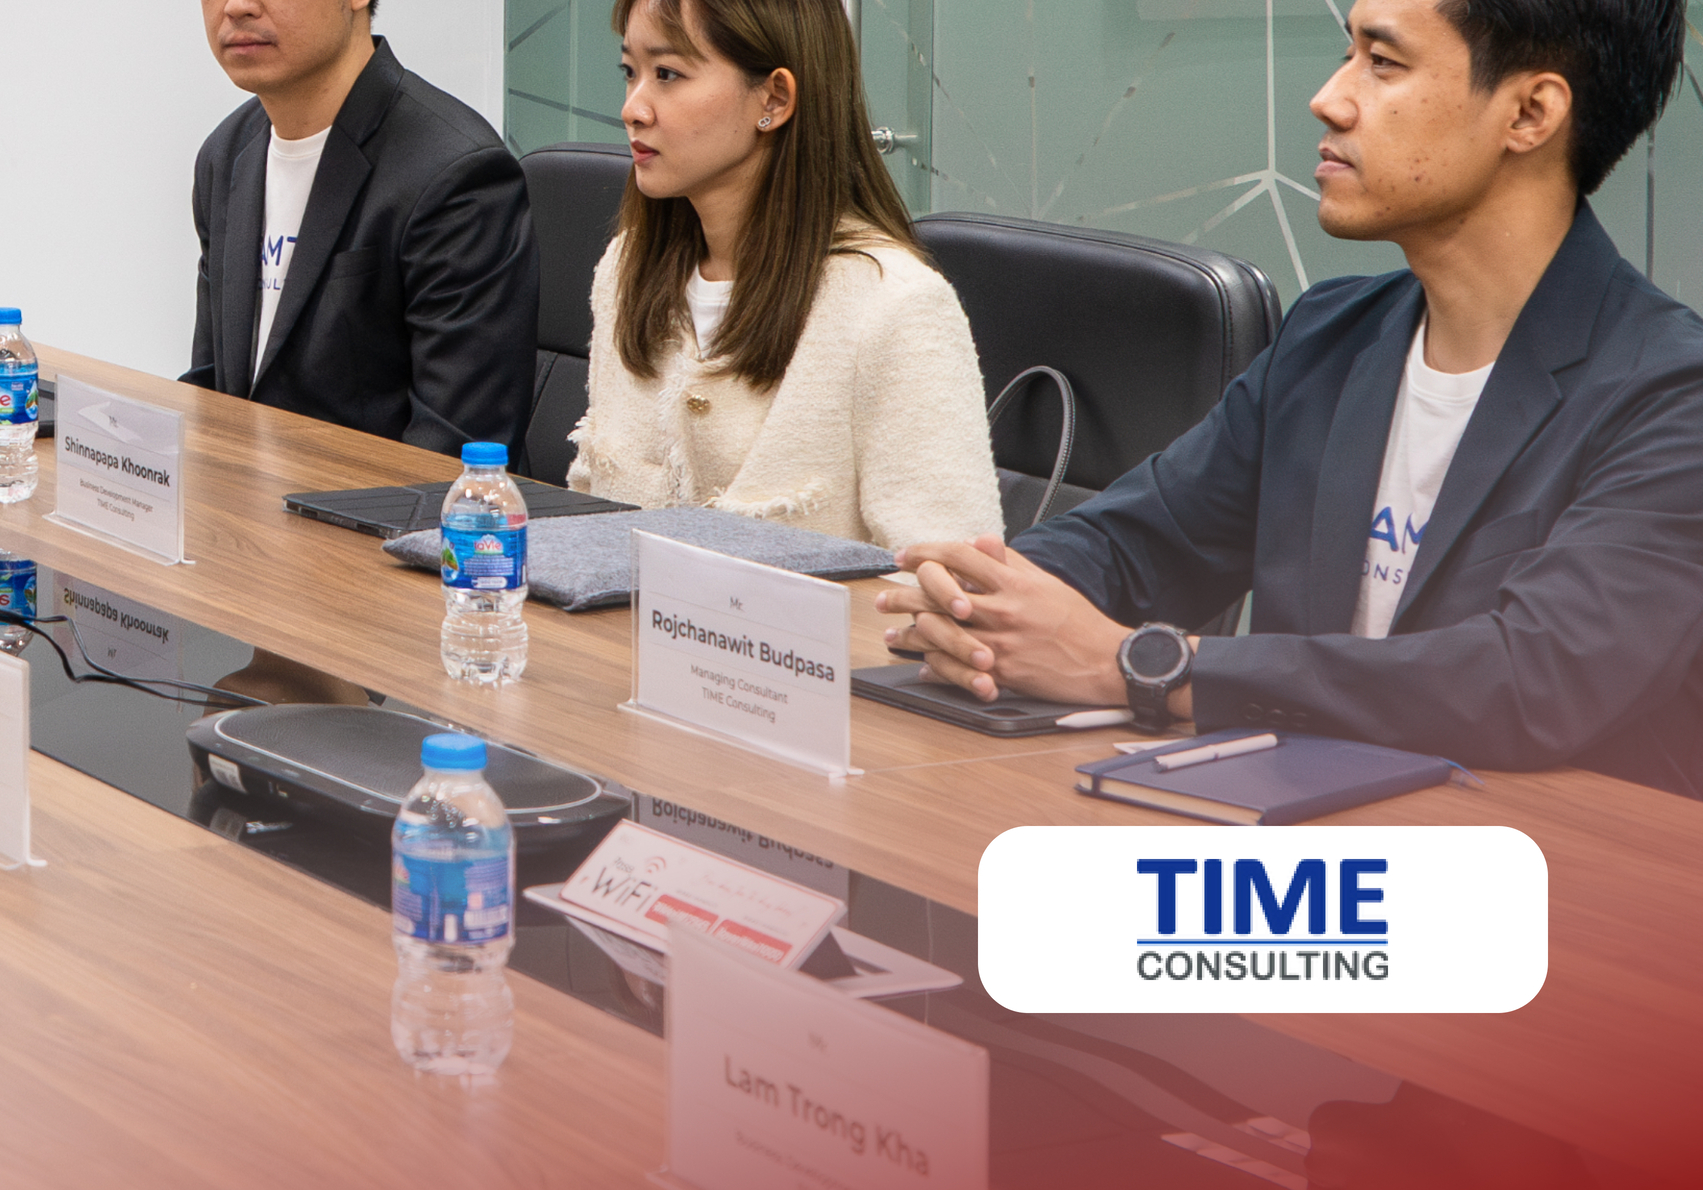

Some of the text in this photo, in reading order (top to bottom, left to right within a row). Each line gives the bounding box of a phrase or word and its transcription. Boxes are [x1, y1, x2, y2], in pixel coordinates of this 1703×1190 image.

[65, 436, 170, 488] Shinnapapa Khoonrak
[651, 609, 835, 683] Rojchanawit Budpasa
[690, 664, 788, 705] Managing Consultant
[701, 687, 776, 723] TIME Consulting
[725, 1055, 779, 1108] Lam
[787, 1083, 866, 1155] Trong
[875, 1123, 929, 1178] Kha
